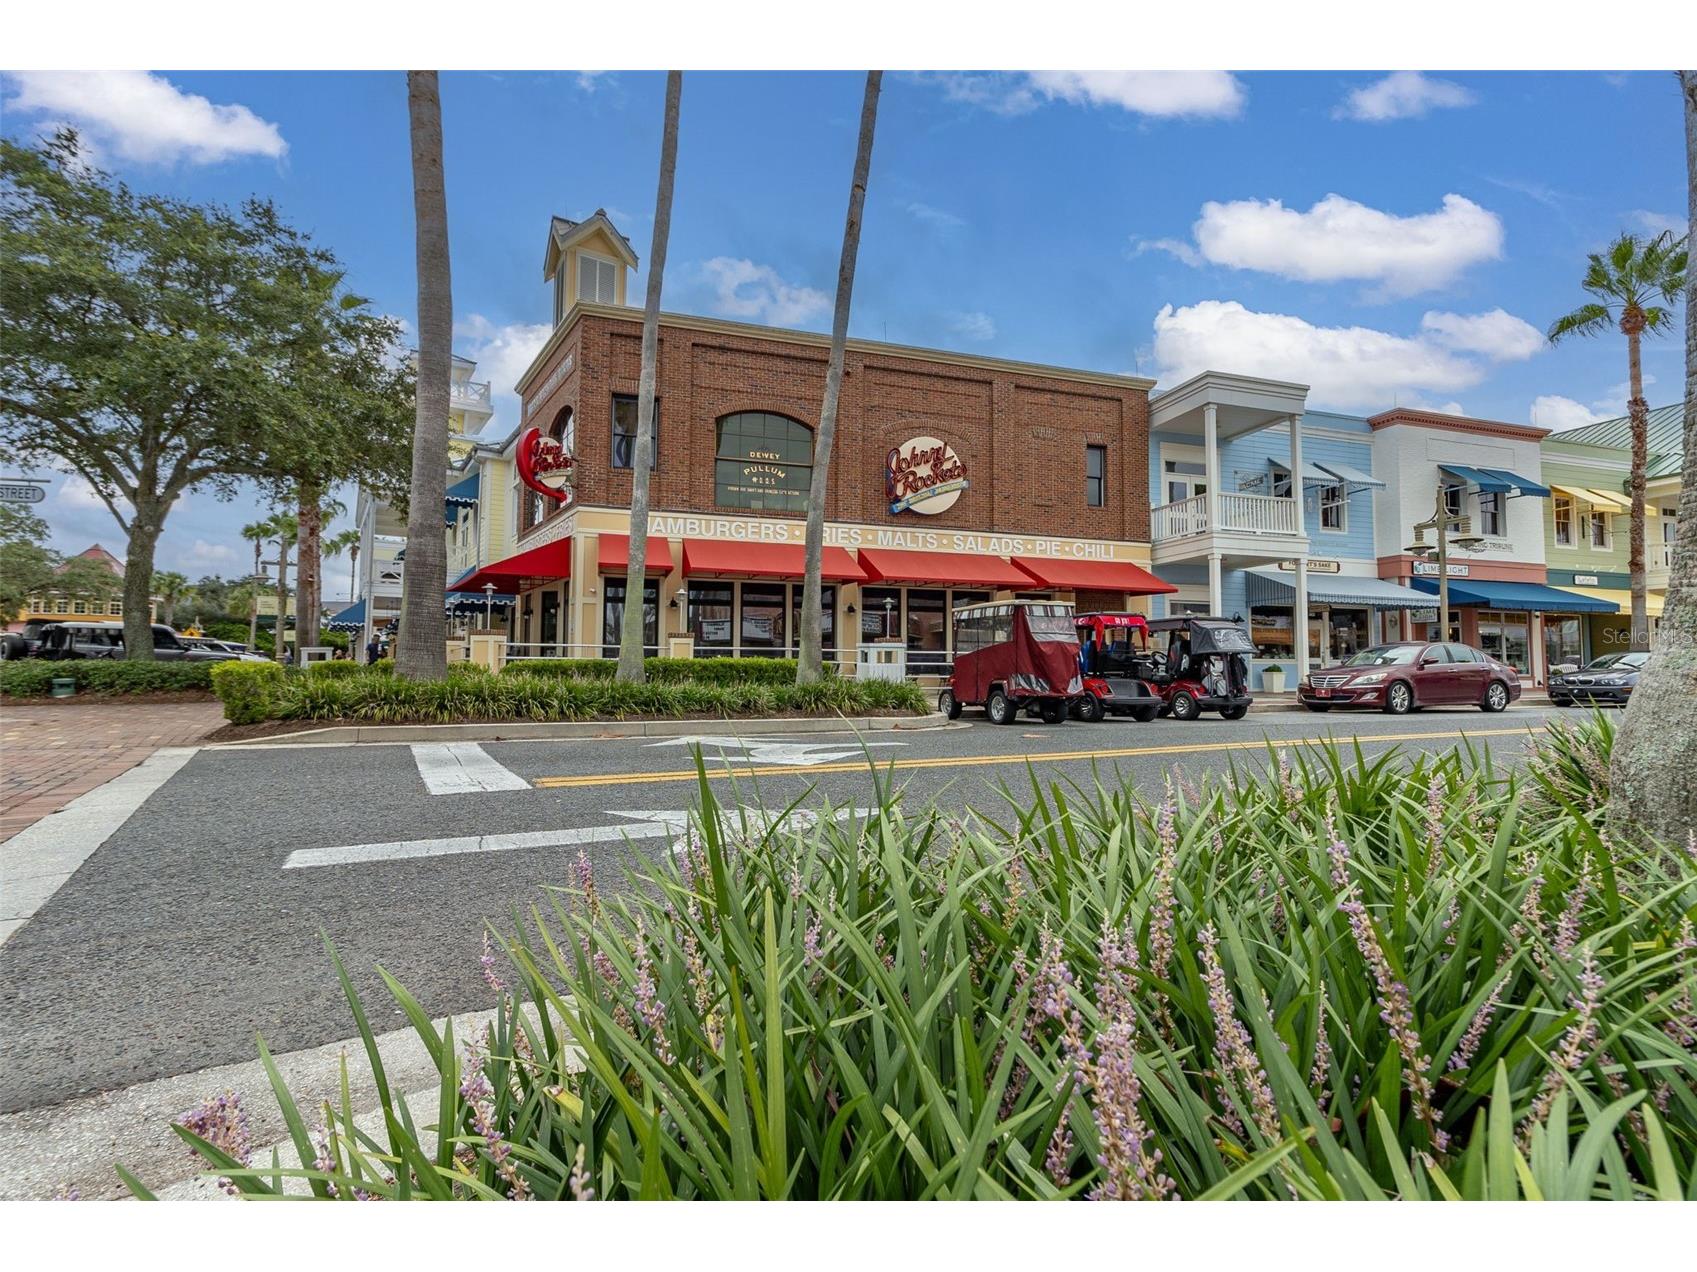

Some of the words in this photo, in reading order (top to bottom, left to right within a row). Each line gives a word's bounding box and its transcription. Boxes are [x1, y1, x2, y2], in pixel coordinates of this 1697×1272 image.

[749, 451, 780, 460] DEWEY
[886, 442, 954, 479] Johnny
[743, 465, 786, 479] PULLUM
[893, 460, 967, 497] Rockets
[0, 487, 37, 499] STREET
[647, 516, 788, 541] AMBURGERS
[822, 527, 862, 545] RIES
[877, 531, 937, 549] MALTS
[953, 535, 1024, 554] SALADS
[1035, 540, 1061, 556] PIE
[1072, 543, 1115, 560] CHILI
